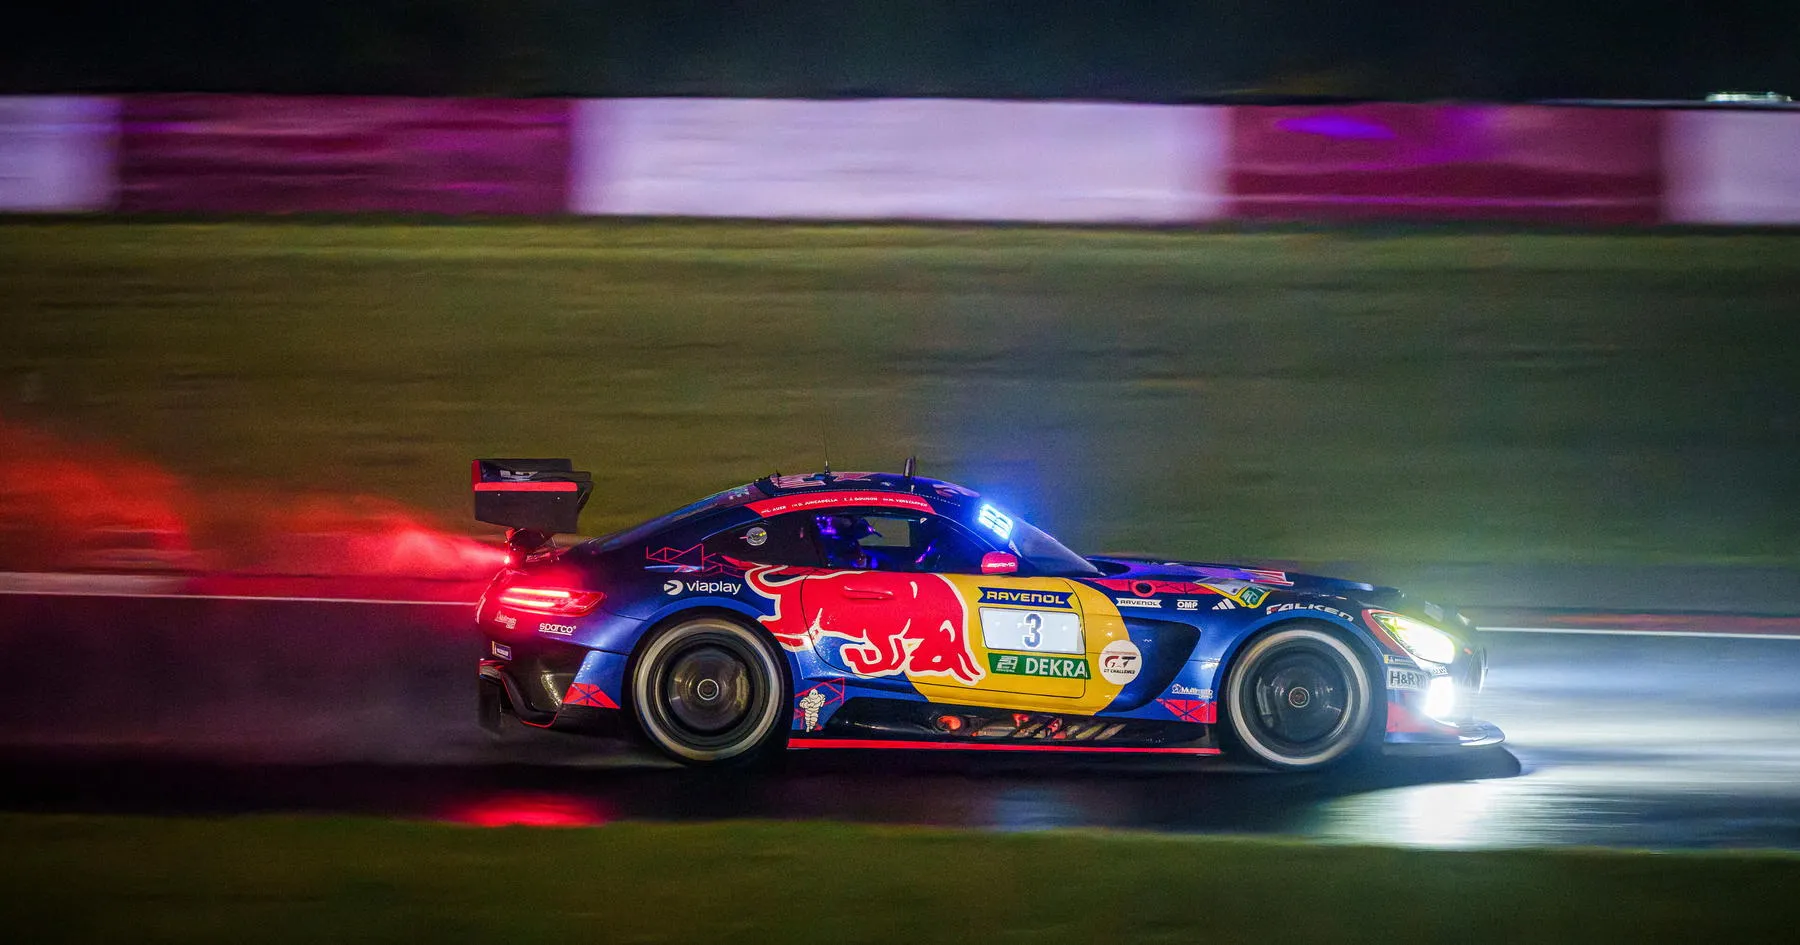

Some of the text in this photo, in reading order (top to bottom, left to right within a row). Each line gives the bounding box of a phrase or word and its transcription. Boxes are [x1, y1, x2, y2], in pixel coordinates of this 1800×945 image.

[686, 580, 742, 595] viaplay
[986, 591, 1065, 605] RAVENOL
[1266, 603, 1354, 622] FALKEN
[1023, 612, 1043, 649] 3
[1025, 657, 1088, 678] DEKRA
[1389, 670, 1415, 685] H&R
